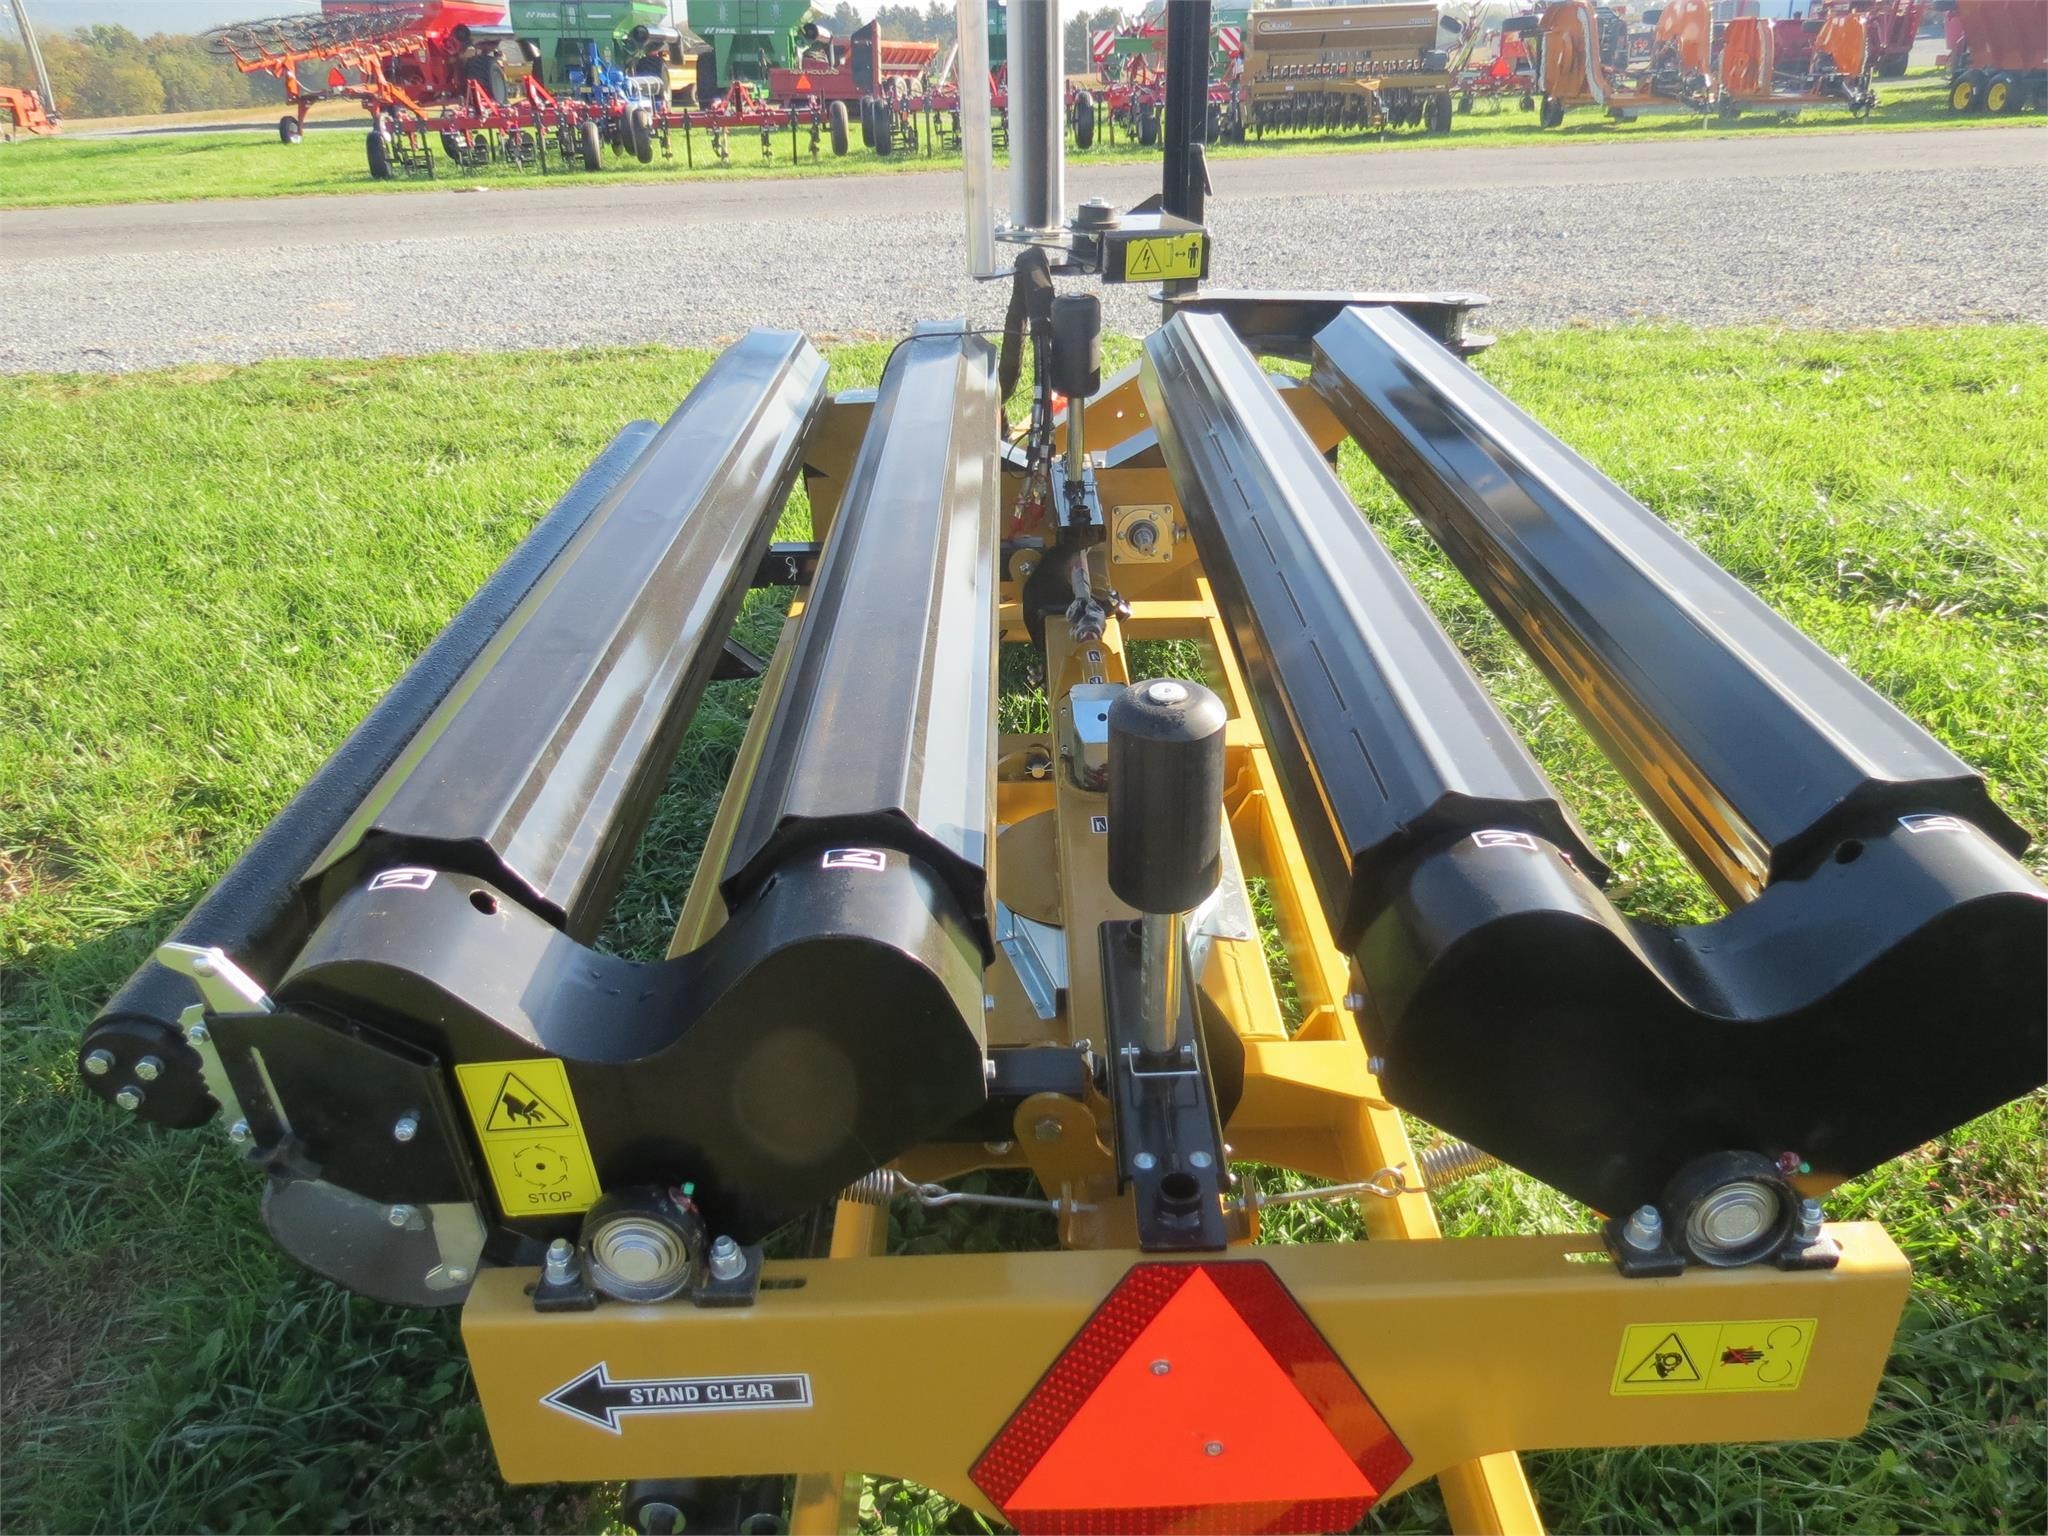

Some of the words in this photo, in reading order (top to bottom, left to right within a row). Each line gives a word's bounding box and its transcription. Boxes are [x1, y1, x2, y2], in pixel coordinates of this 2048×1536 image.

[528, 1191, 573, 1204] STOP
[630, 1386, 700, 1403] STAND
[706, 1383, 775, 1400] CLEAR
